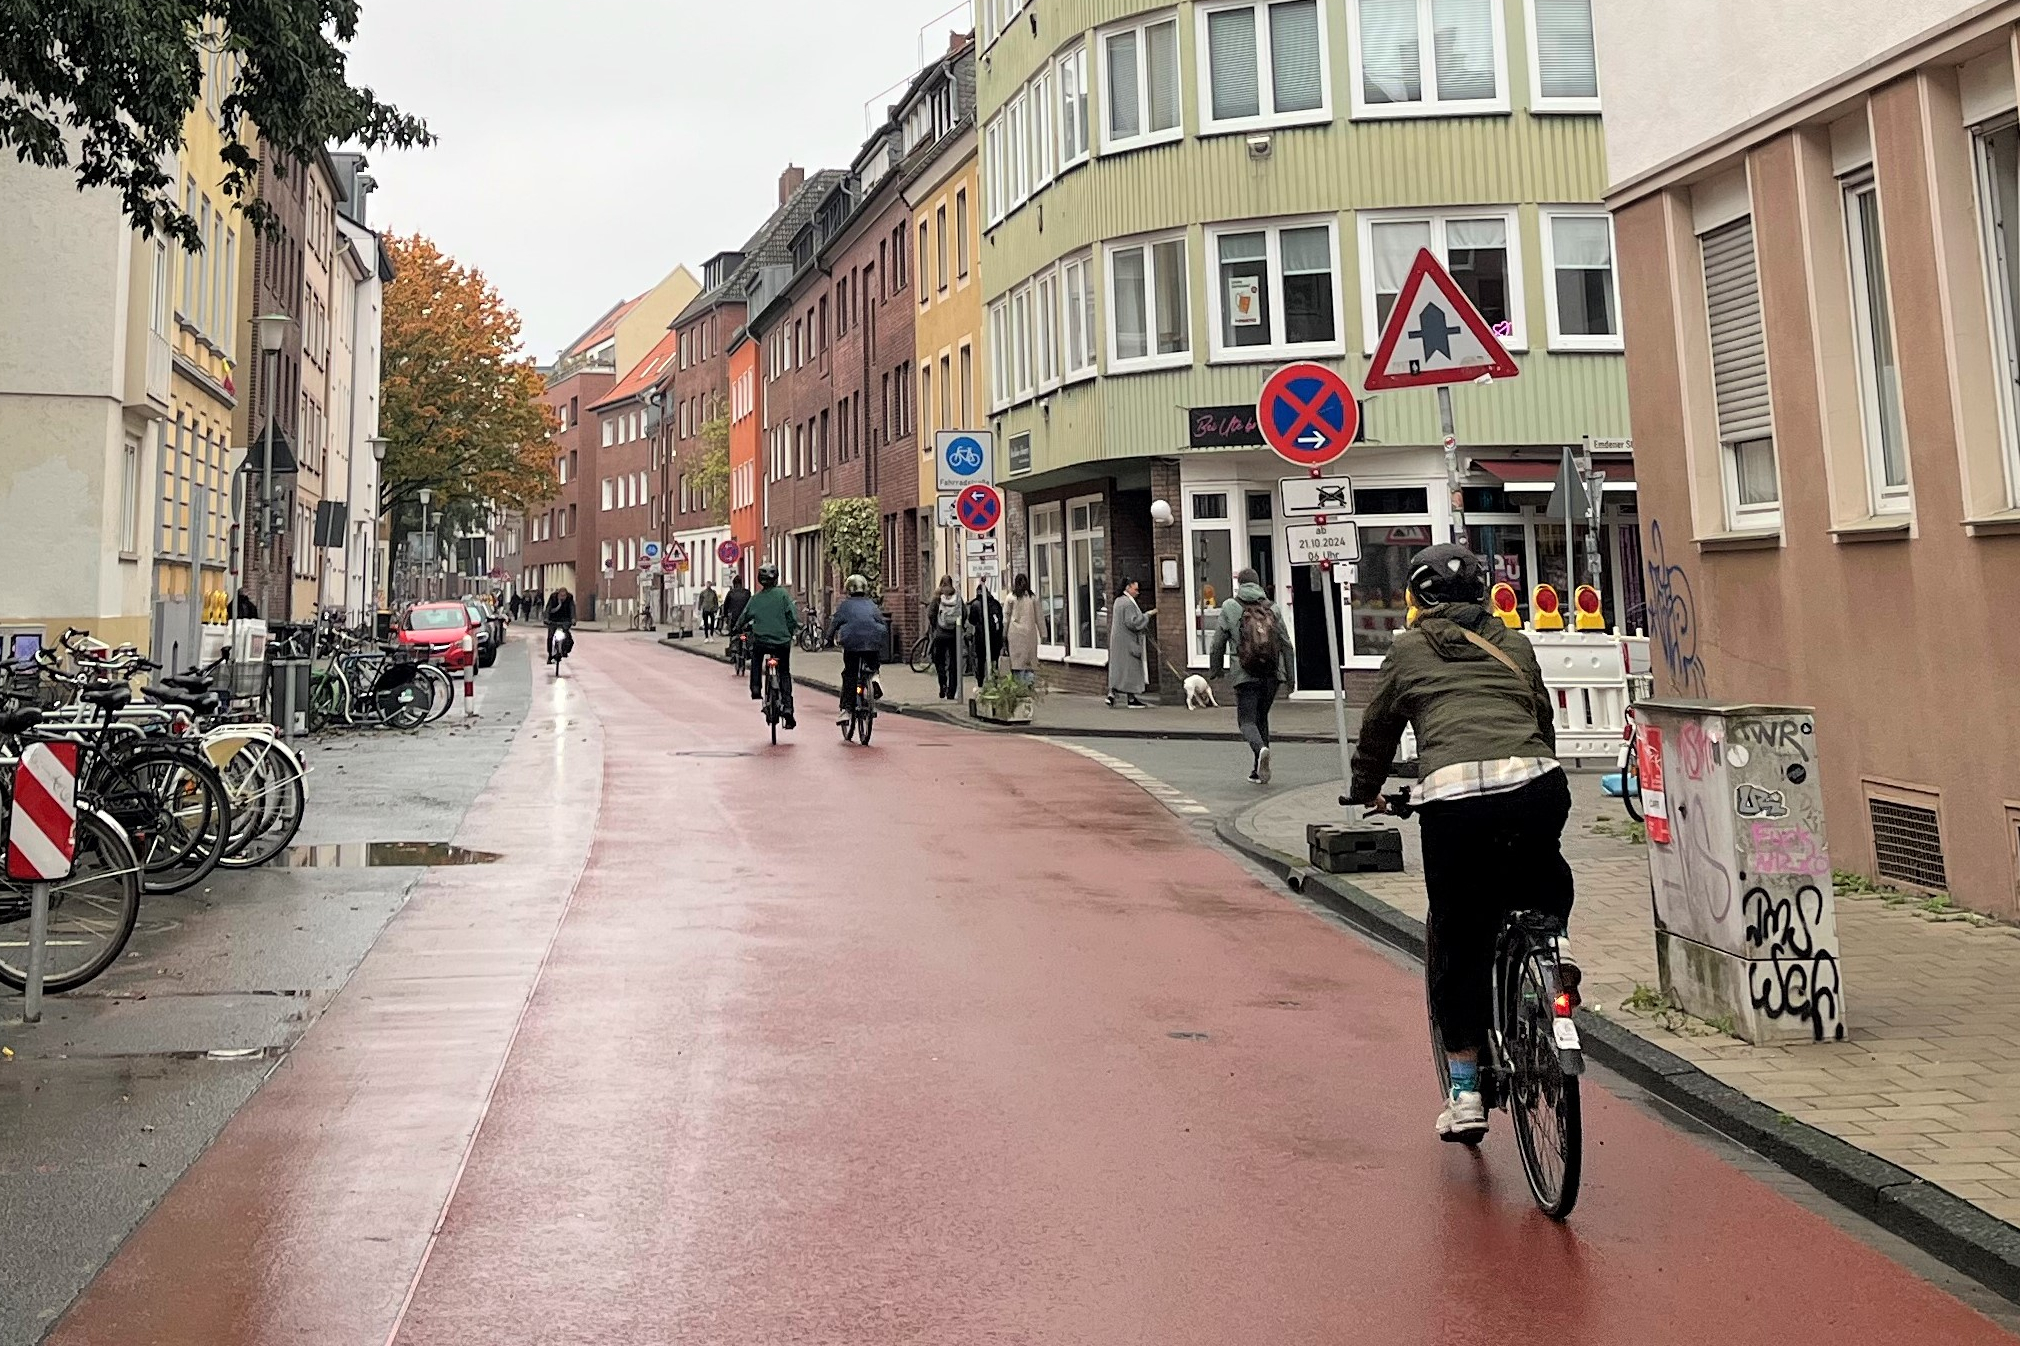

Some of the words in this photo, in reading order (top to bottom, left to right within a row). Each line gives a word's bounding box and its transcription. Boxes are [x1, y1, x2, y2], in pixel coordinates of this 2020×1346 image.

[1315, 526, 1327, 535] ab
[1299, 537, 1346, 549] 21.10.2024
[1308, 551, 1320, 562] 06
[1322, 551, 1340, 560] Uhr
